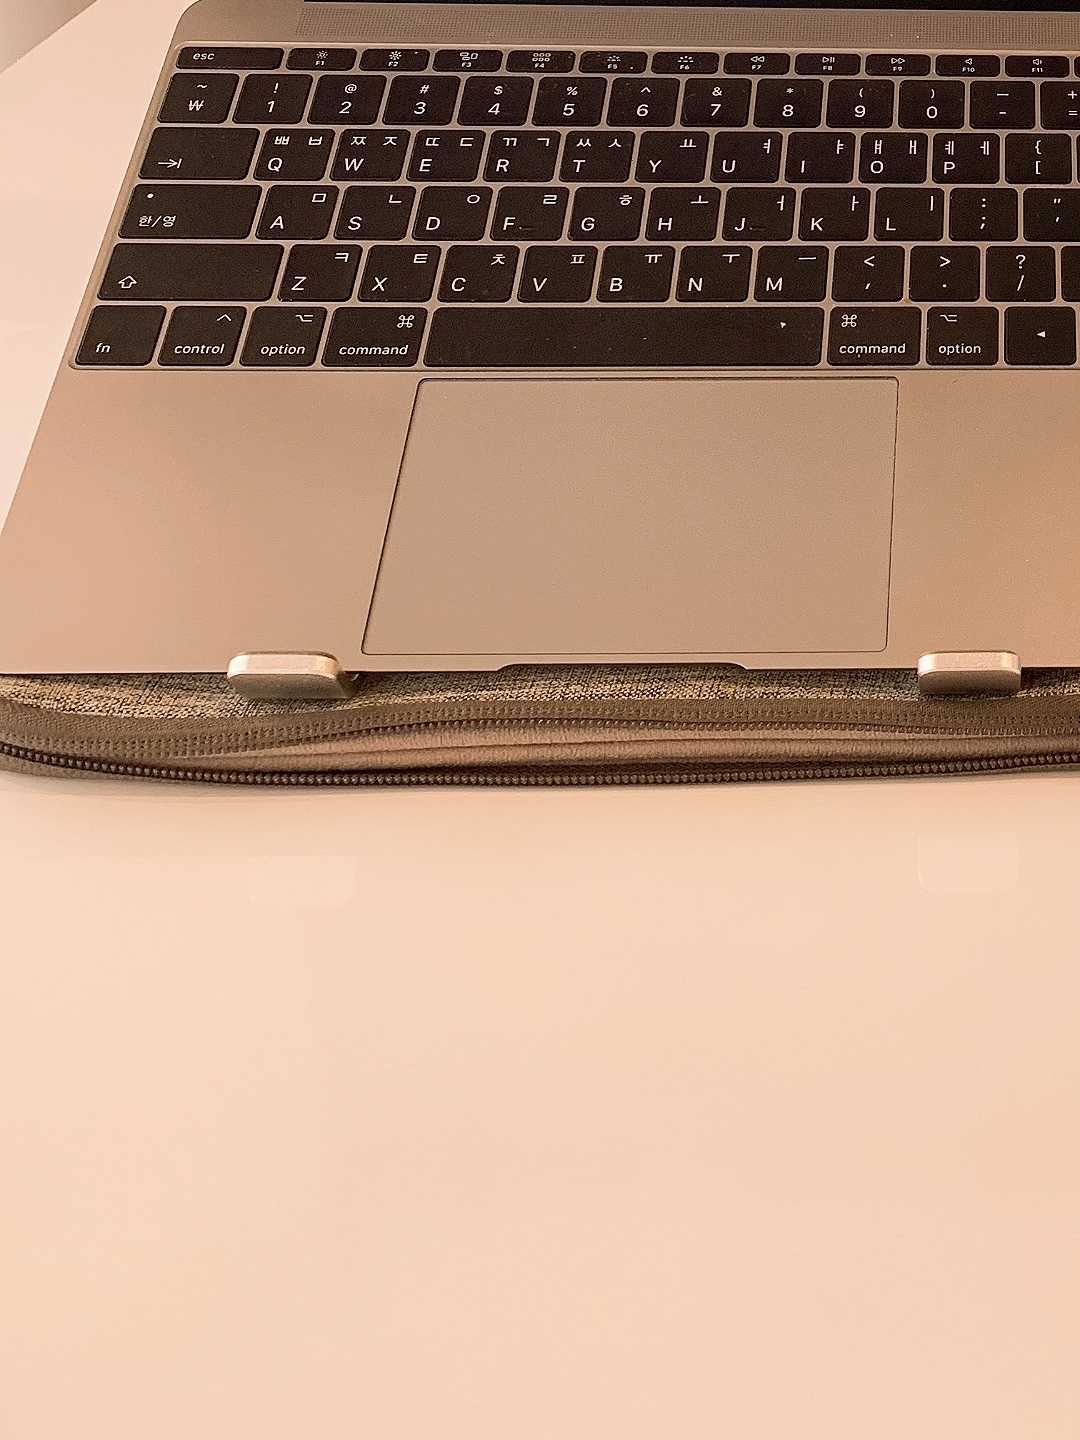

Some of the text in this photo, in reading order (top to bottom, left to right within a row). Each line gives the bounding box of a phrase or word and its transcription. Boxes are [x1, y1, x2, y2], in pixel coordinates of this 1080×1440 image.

[192, 51, 215, 61] esc
[138, 215, 177, 228] 한/영
[95, 342, 111, 354] fn
[174, 344, 226, 356] control
[260, 344, 306, 358] option
[338, 343, 409, 357] command
[838, 342, 907, 355] command
[937, 343, 983, 356] option
